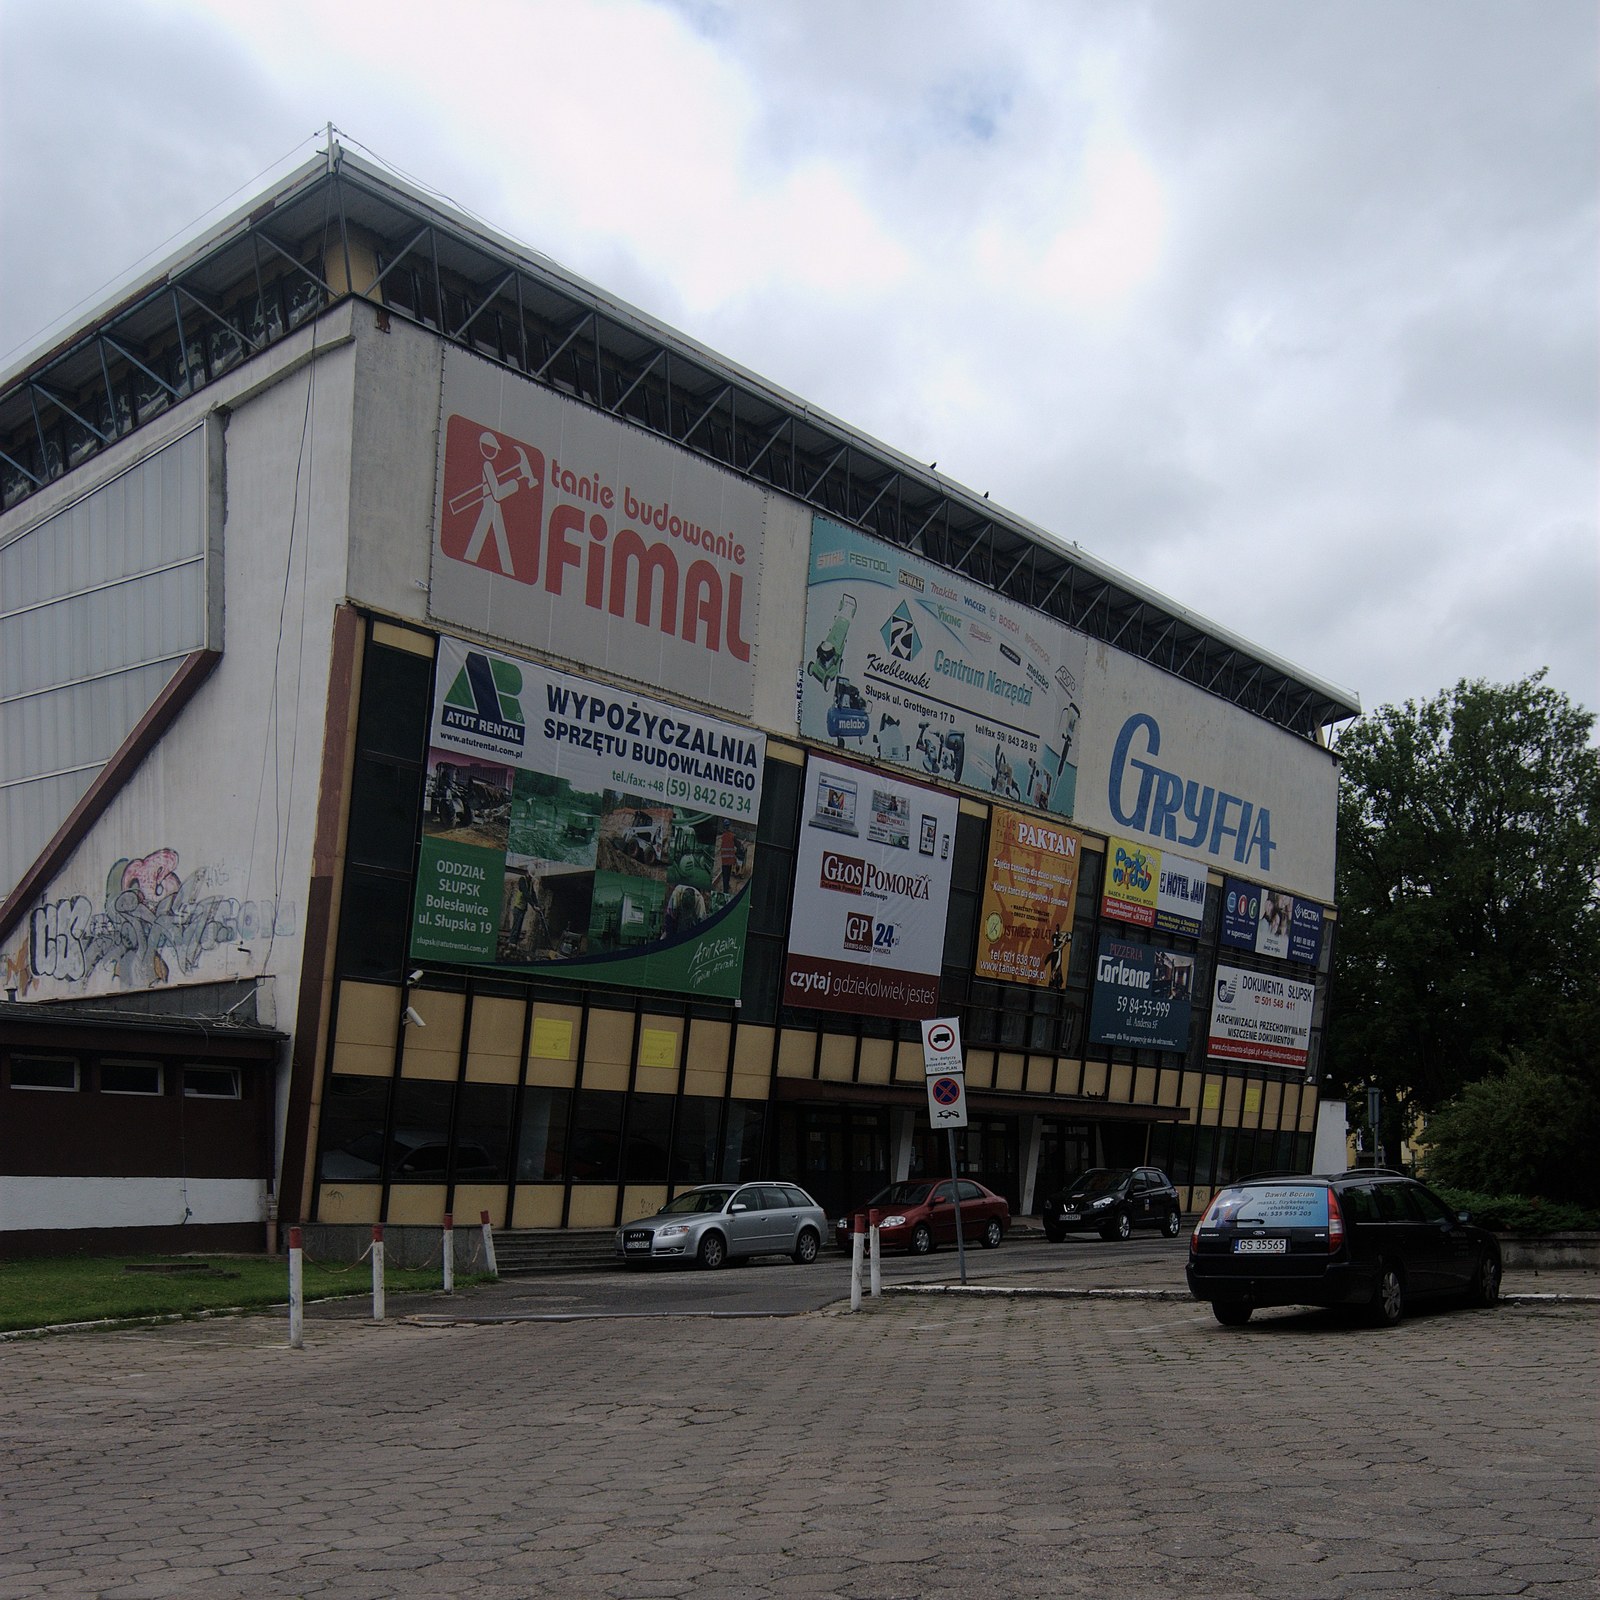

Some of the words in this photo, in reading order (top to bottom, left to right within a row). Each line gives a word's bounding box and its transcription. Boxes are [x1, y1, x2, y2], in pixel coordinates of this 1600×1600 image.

[551, 458, 614, 509] tanie
[625, 486, 745, 565] budowanie
[850, 553, 891, 574] FESTOOL
[999, 614, 1020, 634] BOSCH
[867, 653, 931, 689] Kneblewski
[934, 649, 985, 688] Centrum
[986, 670, 1033, 706] Narzędzi
[865, 684, 891, 702] Słupsk
[903, 698, 938, 719] Grottgera
[446, 713, 477, 733] ATUT
[478, 720, 521, 742] RENTAL
[546, 684, 758, 769] WYPOŻYCZALNIA
[838, 719, 866, 729] metabo
[440, 731, 523, 759] www.atutrental.com.pl
[543, 718, 627, 757] SPRZĘTU
[633, 742, 756, 792] BUDOWLANEGO
[612, 769, 646, 789] tel./fax:
[647, 780, 664, 793] +48
[666, 777, 691, 803] (59)
[693, 784, 716, 806] 842
[719, 790, 734, 810] 62
[736, 793, 751, 814] 34
[1018, 822, 1077, 858] PAKTAN
[436, 860, 486, 880] ODDZIAŁ
[824, 855, 862, 885] GŁOS
[865, 863, 930, 900] POMORZA
[438, 878, 481, 897] SŁUPSK
[1166, 871, 1189, 901] HOTEL
[1190, 879, 1205, 905] JAN
[426, 894, 489, 916] Bolesławice
[418, 912, 432, 925] ul.
[434, 914, 476, 932] Słupska
[479, 921, 492, 934] 19
[846, 917, 869, 941] GP
[990, 949, 1002, 961] tel.
[1109, 943, 1143, 961] PIZZERIA
[1097, 954, 1150, 989] Corleone
[789, 970, 831, 995] czytaj
[833, 974, 904, 1001] gdziekolwiek
[904, 984, 935, 1006] jesteś
[1242, 975, 1284, 997] DOKUMENTA
[1287, 985, 1312, 1003] SŁUPSK
[1117, 995, 1128, 1012] 59
[1129, 997, 1171, 1018] 84-55-999
[1216, 1013, 1258, 1029] ARCHIWIZACJA
[1259, 1020, 1307, 1037] PRZECHOWYWANIE
[1239, 1240, 1253, 1250] GS
[1256, 1240, 1285, 1250] 35565
